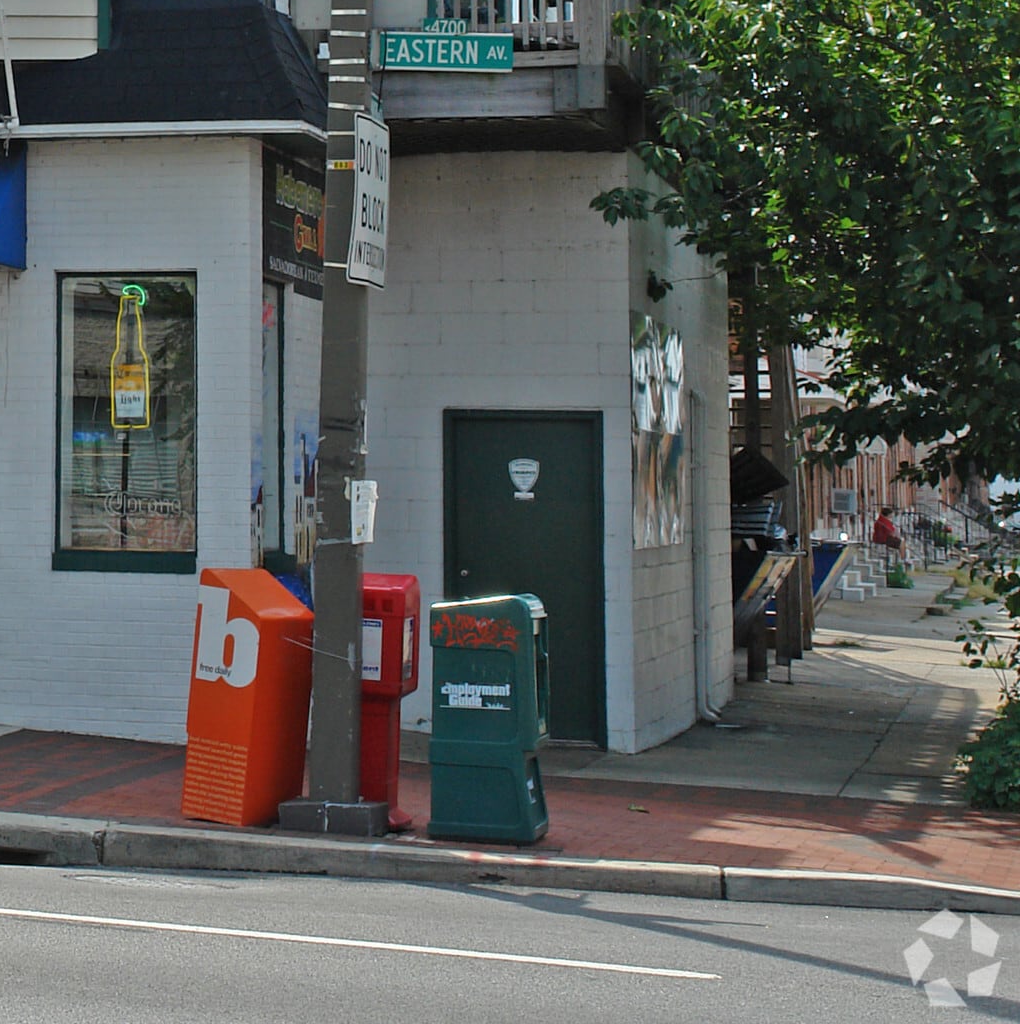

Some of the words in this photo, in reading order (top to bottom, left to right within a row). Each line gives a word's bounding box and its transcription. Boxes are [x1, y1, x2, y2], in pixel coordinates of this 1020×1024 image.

[429, 20, 466, 34] 4700
[385, 37, 479, 65] EASTERN
[486, 45, 508, 61] AV.
[359, 138, 371, 175] DO
[199, 663, 213, 674] free
[215, 666, 232, 677] daily
